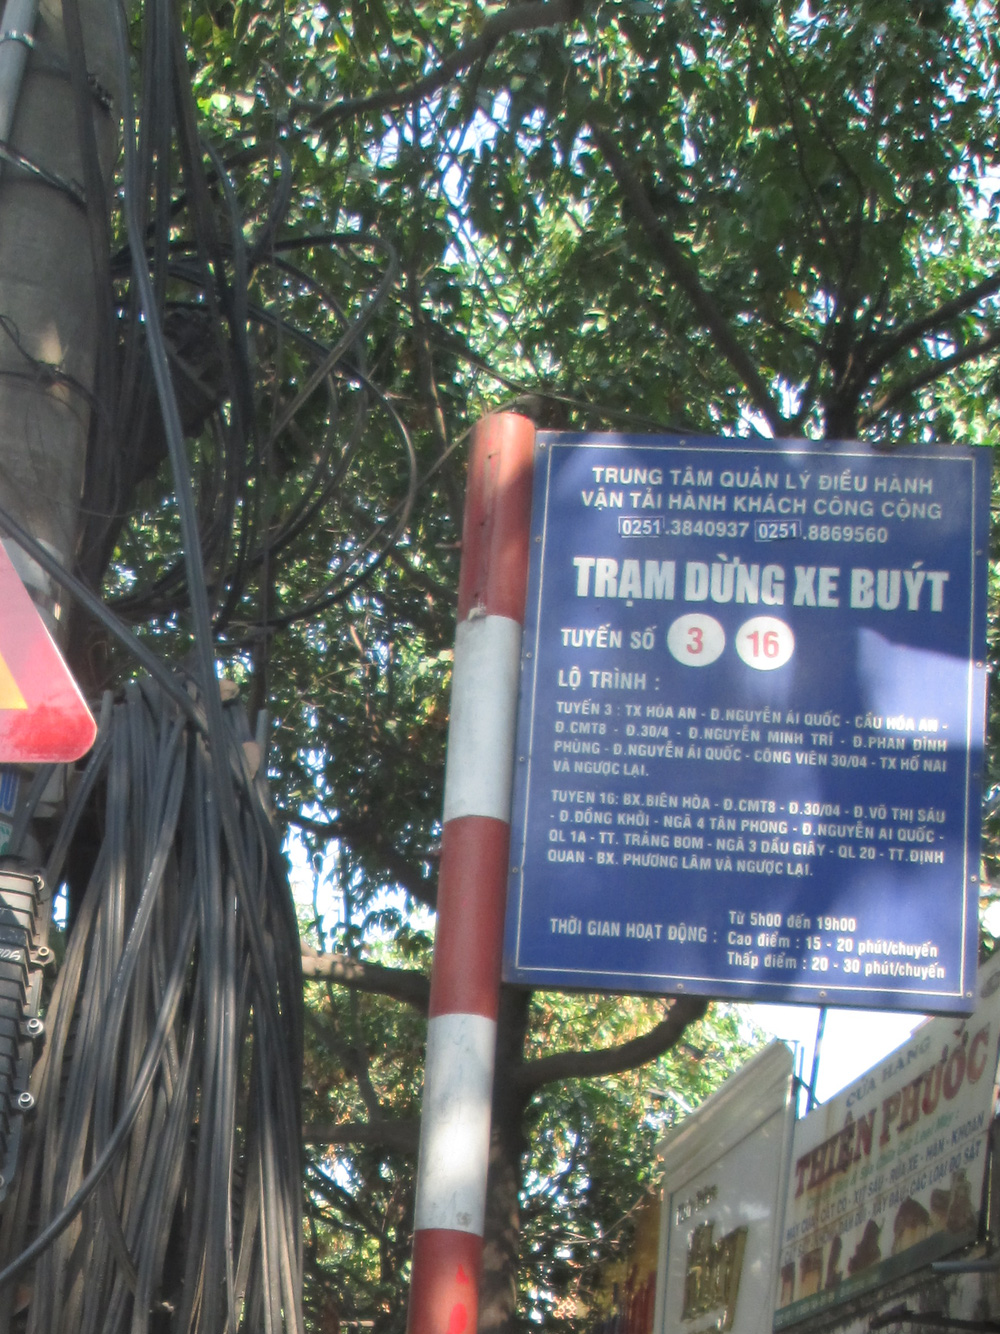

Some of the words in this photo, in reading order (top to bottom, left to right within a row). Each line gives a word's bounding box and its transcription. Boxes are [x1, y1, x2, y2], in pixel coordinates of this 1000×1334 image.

[592, 467, 663, 485] TRUNG
[669, 466, 712, 486] TÂM
[719, 466, 779, 489] QUẢN
[786, 470, 811, 490] LÝ
[819, 469, 867, 492] ĐIỀU
[874, 474, 933, 494] HÀNH
[582, 487, 623, 510] VẬN
[630, 488, 662, 509] TẢI
[668, 490, 726, 511] HÀNH
[733, 493, 806, 514] KHÁCH
[814, 496, 873, 516] CÔNG
[882, 498, 942, 521] CỘNG
[573, 556, 676, 607] TRẠM
[684, 553, 785, 605] DỪNG
[793, 566, 840, 608] XE
[850, 561, 949, 612] BUÝT
[561, 623, 622, 648] TUYẾN
[630, 625, 657, 649] SỐ
[686, 627, 704, 654] 3
[747, 630, 779, 658] 16
[558, 666, 581, 690] LỘ
[590, 667, 647, 690] TRÌNH
[556, 699, 600, 715] TUYẾN
[604, 704, 612, 715] 3
[625, 705, 641, 717] TX
[678, 708, 696, 719] AN
[804, 710, 840, 727] QUỐC
[918, 718, 939, 732] AN
[555, 721, 606, 735] Đ.CMT8
[626, 724, 669, 738] Đ.30/4
[689, 725, 760, 742] Đ.NGUYỄN
[768, 732, 803, 744] MINH
[853, 736, 905, 750] Đ.PHAN
[913, 736, 946, 752] ĐÌNH
[553, 759, 570, 772] VÀ
[574, 761, 620, 776] NGƯỢC
[554, 739, 600, 754] PHÙNG
[613, 741, 683, 758] Đ.NGUYỄN
[705, 745, 741, 761] QUỐC
[754, 748, 791, 764] CÔNG
[796, 752, 827, 766] VIÊN
[831, 755, 867, 768] 30/04
[880, 758, 896, 770] TX
[900, 755, 919, 771] HỐ
[923, 760, 946, 772] NAI
[623, 792, 678, 808] BX.BIÊN
[683, 795, 710, 809] HÒA
[723, 799, 776, 814] Đ.CMT8
[789, 801, 840, 817] Đ.30/04
[854, 804, 886, 819] Đ.VÕ
[892, 808, 913, 823] THỊ
[918, 808, 945, 823] SÁU
[559, 807, 612, 824] Đ.ĐỒNG
[617, 811, 649, 826] KHỞI
[663, 814, 692, 829] NGÃ
[697, 816, 704, 829] 4
[709, 816, 736, 831] TÂN
[741, 819, 788, 834] PHONG
[802, 820, 874, 839] Đ.NGUYỄN
[898, 826, 935, 842] QUỐC
[548, 849, 585, 863] QUAN
[623, 852, 678, 868] PHƯƠNG
[682, 854, 711, 870] LÂM
[715, 857, 732, 871] VÀ
[737, 860, 783, 876] NGƯỢC
[549, 830, 565, 842] QL
[571, 831, 586, 843] 1A
[624, 831, 669, 848] TRẢNG
[674, 836, 703, 849] BOM
[717, 837, 745, 851] NGÃ
[749, 841, 756, 852] 3
[793, 841, 825, 856] GIÂY
[838, 846, 855, 858] QL
[859, 847, 875, 860] 20
[889, 848, 944, 865] TT.ĐỊNH
[551, 915, 582, 934] THỜI
[587, 920, 620, 937] GIAN
[626, 922, 662, 941] HOẠT
[668, 923, 707, 944] ĐỘNG
[729, 910, 745, 925] Từ
[751, 913, 782, 927] 5h00
[787, 914, 811, 930] đến
[817, 917, 856, 932] 19h00
[728, 931, 751, 945] Cao
[758, 931, 790, 948] điểm
[806, 937, 821, 950] 15
[837, 939, 853, 952] 20
[858, 940, 938, 959] phút/chuyến
[727, 950, 758, 969] Thấp
[764, 952, 797, 969] điểm
[812, 957, 828, 971] 20
[843, 959, 860, 973] 30
[865, 961, 945, 980] phút/chuyến
